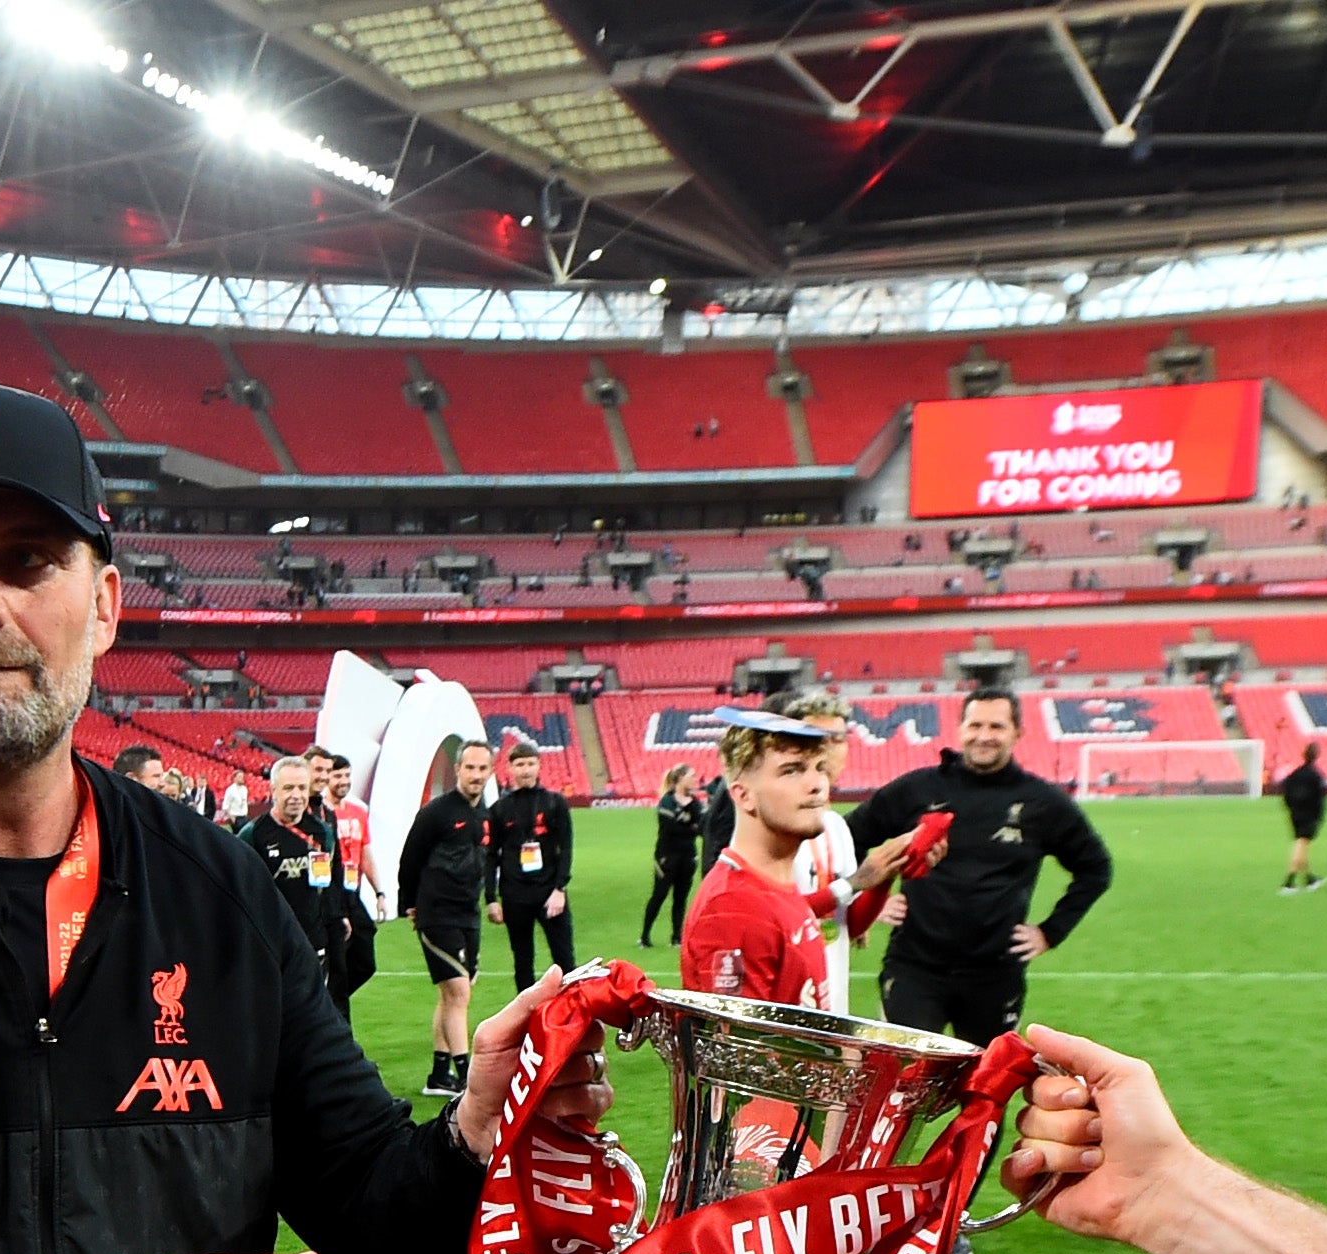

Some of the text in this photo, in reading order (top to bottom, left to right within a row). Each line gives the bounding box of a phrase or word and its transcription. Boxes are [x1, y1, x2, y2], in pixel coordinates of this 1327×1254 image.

[986, 440, 1174, 476] THANK YOU
[978, 470, 1182, 506] FOR COMING
[154, 1027, 188, 1044] LFC
[115, 1058, 223, 1112] AXA
[532, 1136, 593, 1215] FLY
